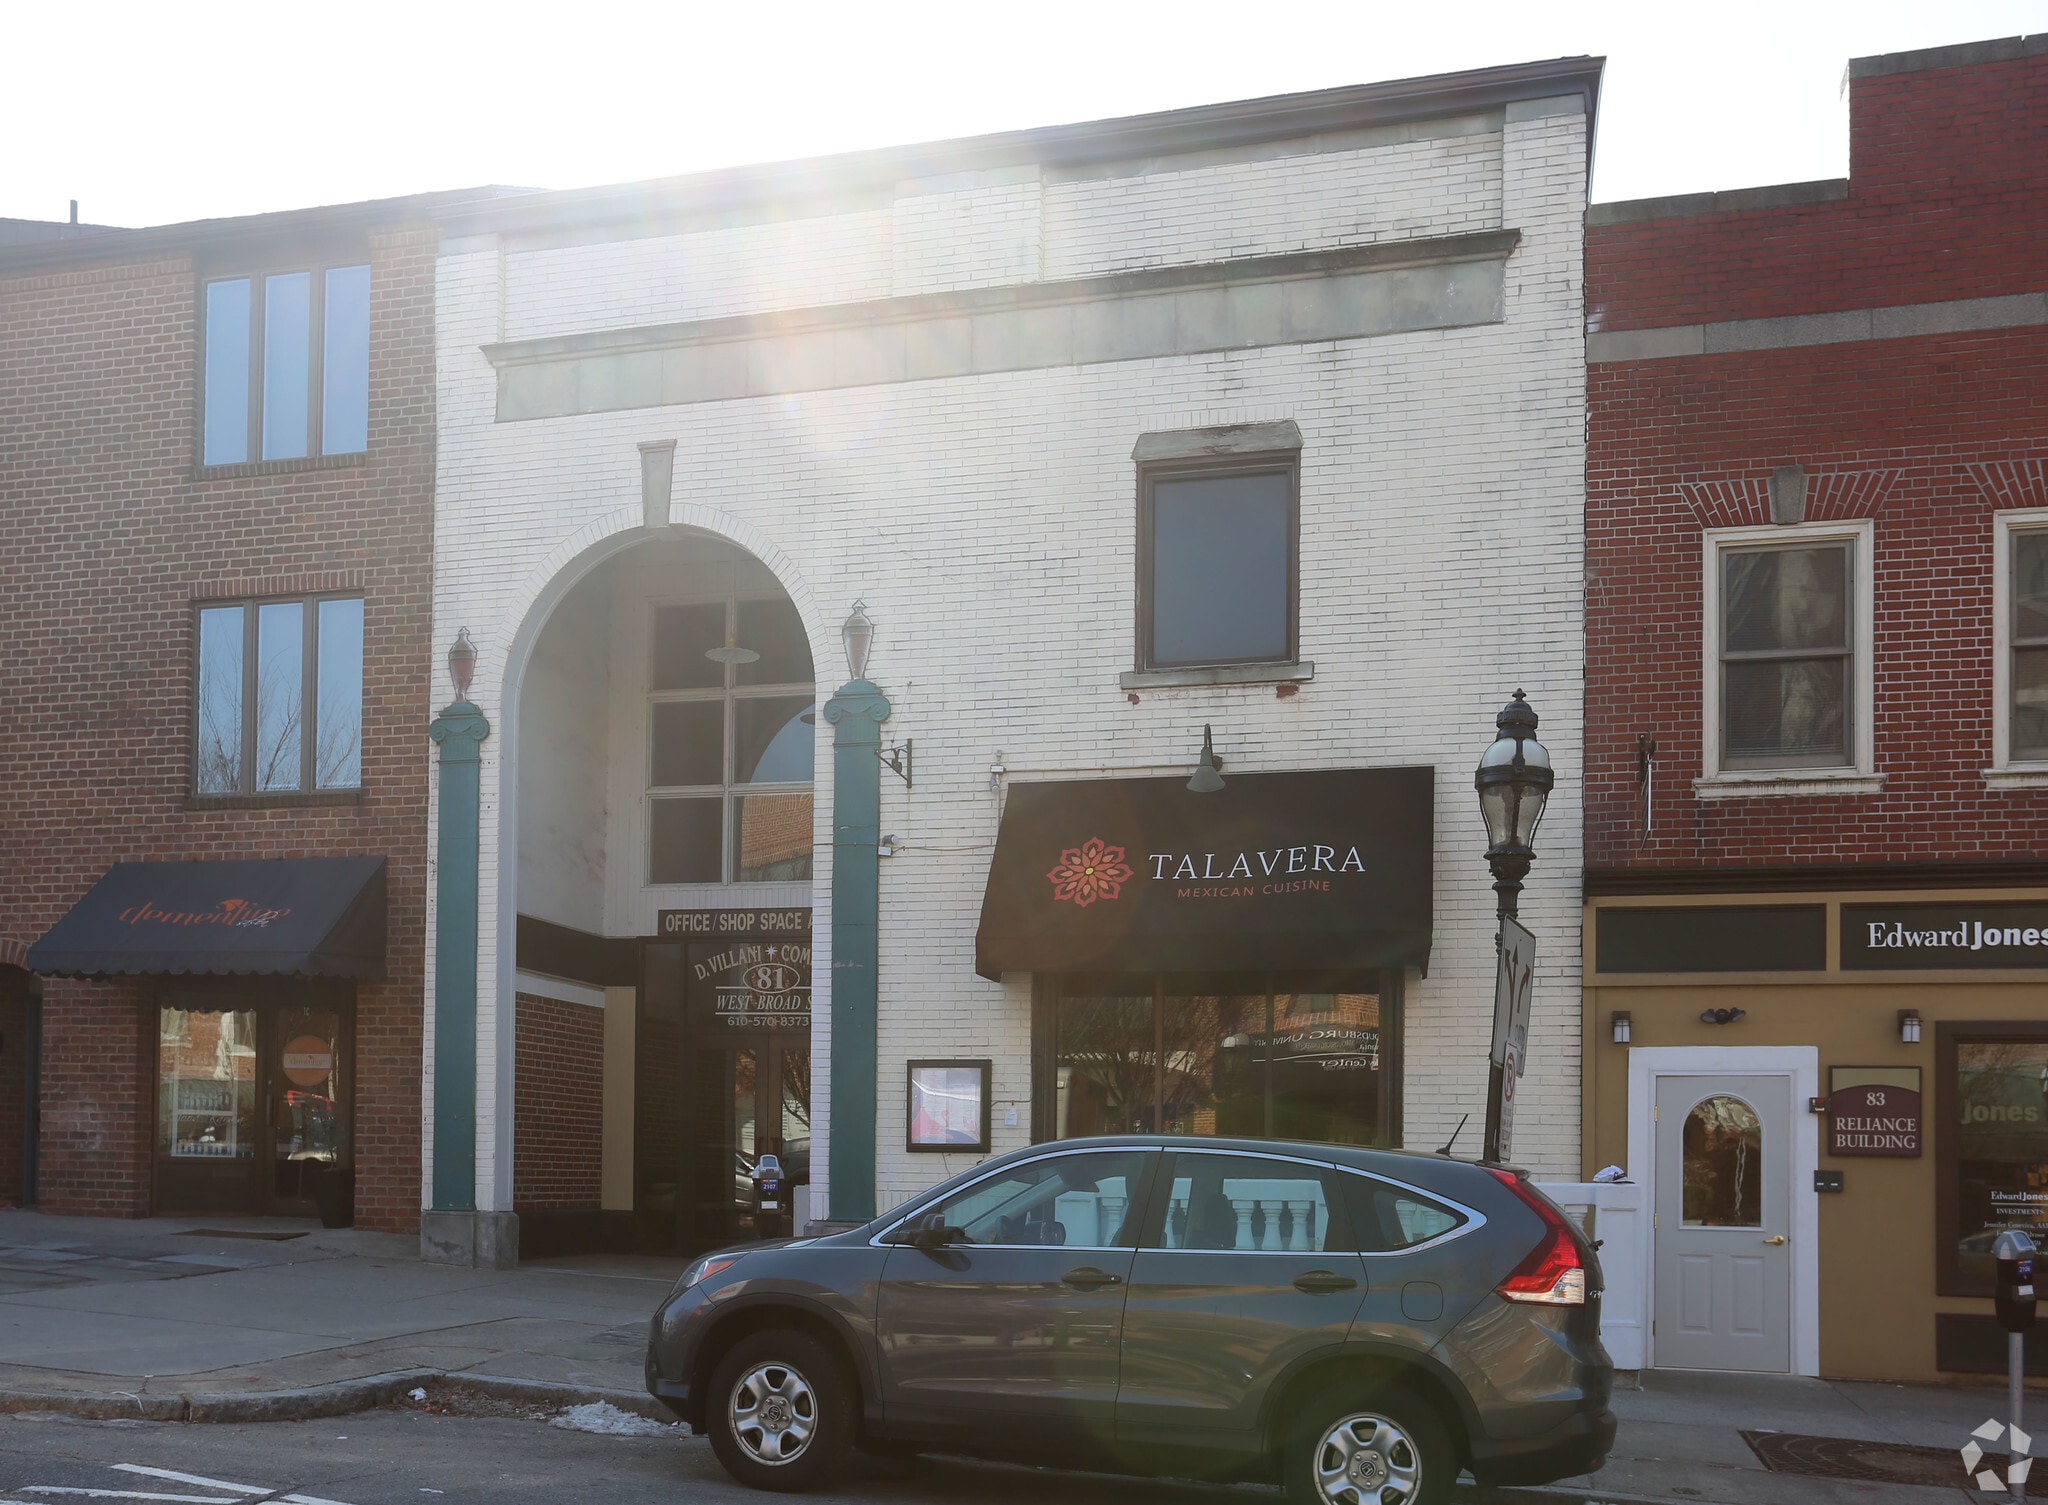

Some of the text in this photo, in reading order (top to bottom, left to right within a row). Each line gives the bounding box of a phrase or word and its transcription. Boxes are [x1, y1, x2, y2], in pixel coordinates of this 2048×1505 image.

[1149, 844, 1366, 880] TALAVERA
[1177, 880, 1331, 898] MEXICAN CUISINE
[760, 912, 802, 930] SPACE
[781, 945, 812, 966] COM
[757, 966, 785, 990] 81
[717, 995, 753, 1010] WEST
[757, 995, 801, 1010] BROAD
[727, 1016, 809, 1027] 610-570-8373
[1866, 1092, 1886, 1106] 83
[1961, 1100, 2039, 1124] Jones
[1836, 1117, 1917, 1132] RELIANCE
[1836, 1134, 1916, 1149] BUILDING
